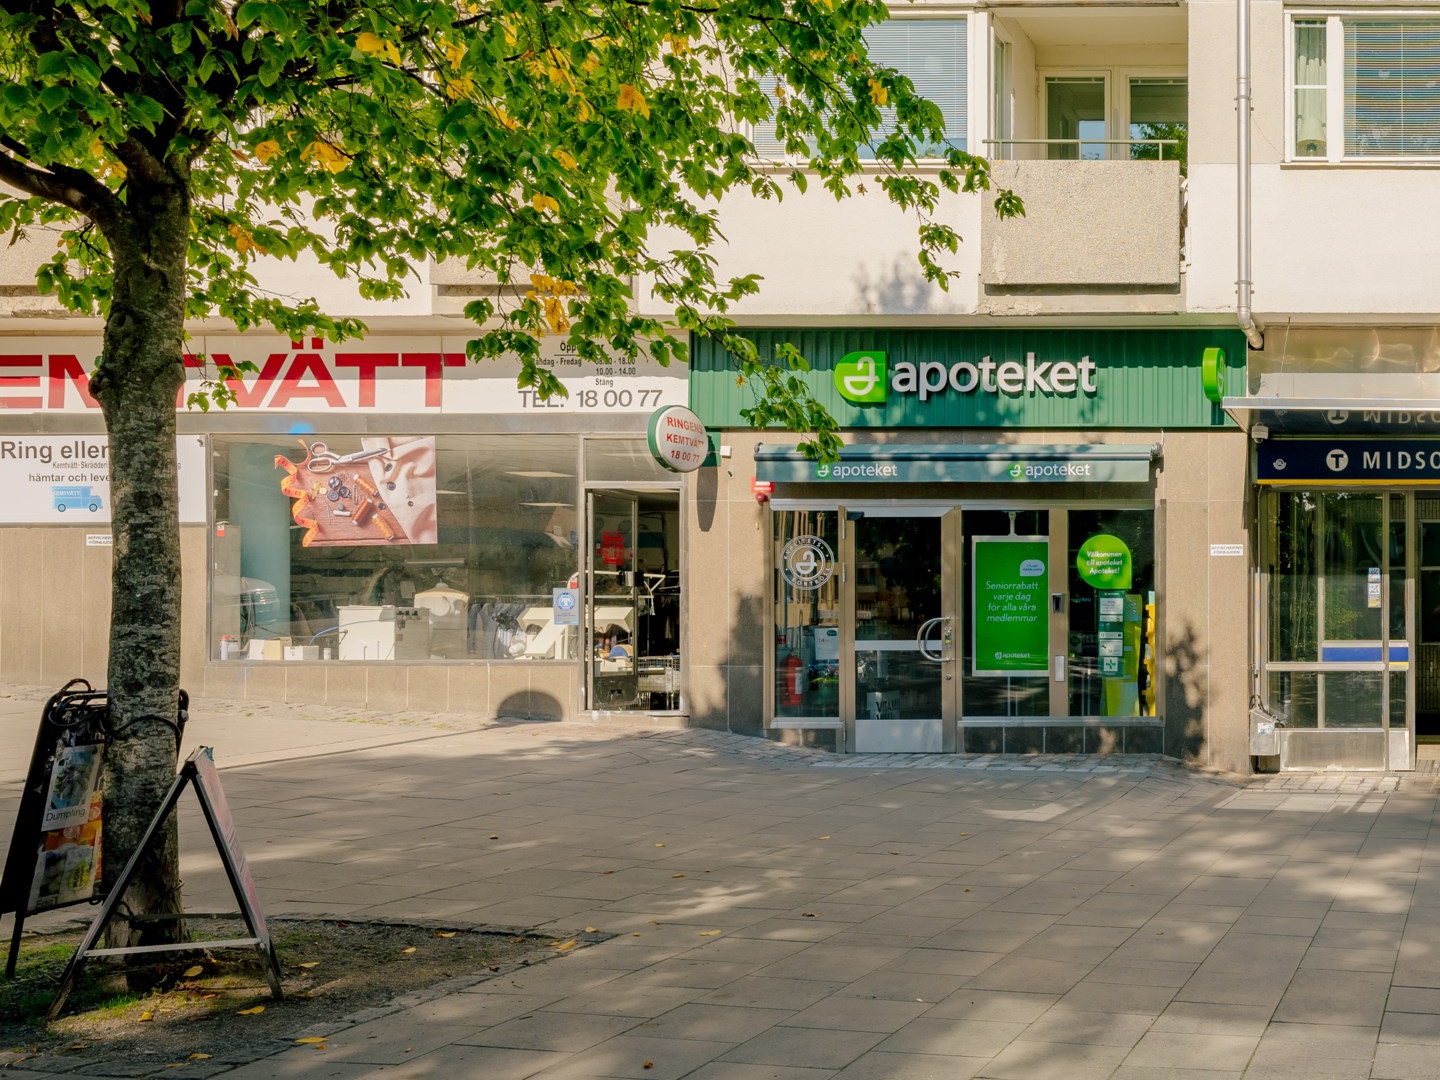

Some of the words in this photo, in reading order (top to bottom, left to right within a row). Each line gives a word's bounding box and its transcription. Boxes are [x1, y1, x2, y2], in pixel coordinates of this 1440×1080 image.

[560, 358, 582, 367] Fredag
[595, 367, 613, 375] 10.00
[618, 367, 636, 375] 14.00
[892, 352, 1097, 401] apoteket
[576, 390, 598, 407] 18
[604, 390, 632, 408] 00
[637, 390, 663, 407] 77
[666, 416, 704, 435] RINGENS
[1, 441, 52, 463] Ring
[60, 441, 108, 459] eller
[671, 449, 681, 460] 18
[682, 451, 691, 461] 00
[692, 453, 700, 463] 77
[1330, 453, 1344, 469] T
[29, 472, 64, 481] hämtar
[68, 473, 87, 481] och
[832, 463, 898, 479] apoteket
[1025, 462, 1090, 478] apoteket
[1096, 559, 1123, 567] apoteket
[985, 580, 1039, 591] Seniorrabatt
[993, 592, 1014, 602] varje
[1015, 591, 1031, 602] dag
[988, 602, 1000, 612] för
[1002, 603, 1017, 612] alla
[1018, 602, 1037, 612] våra
[986, 613, 1038, 622] medlemmar
[46, 807, 87, 822] Dumpling
